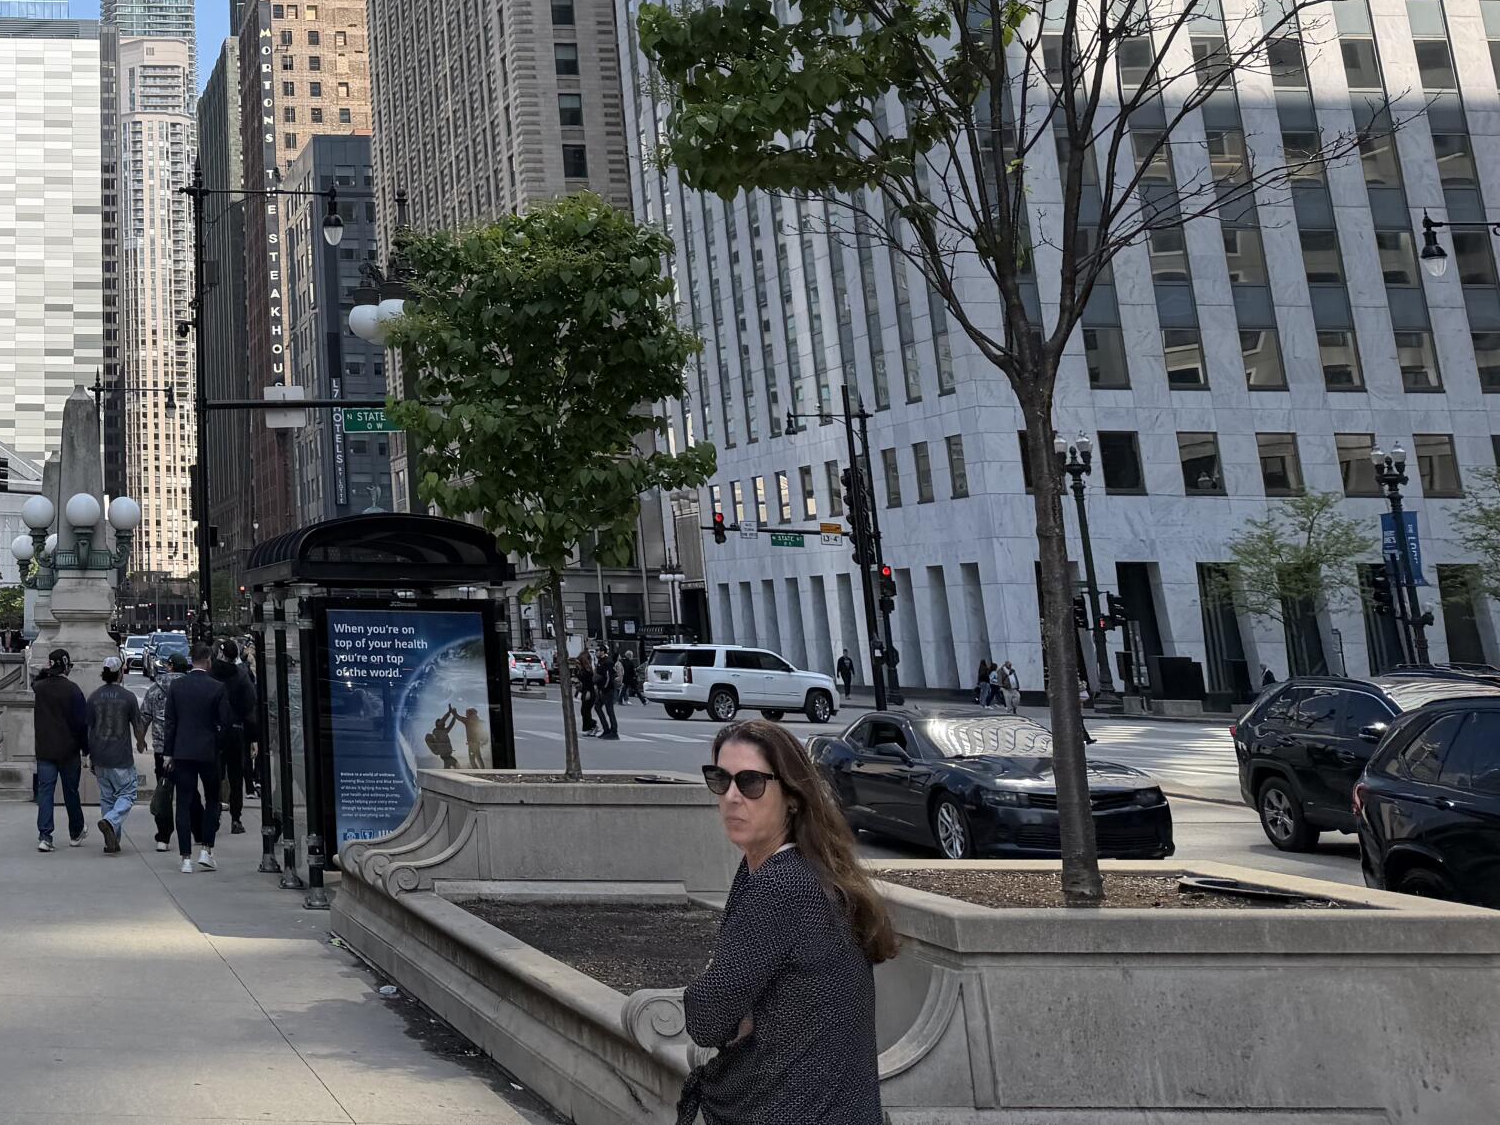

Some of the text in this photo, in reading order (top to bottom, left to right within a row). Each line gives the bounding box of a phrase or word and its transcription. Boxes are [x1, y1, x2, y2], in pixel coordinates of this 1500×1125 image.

[260, 28, 274, 143] MORTONS
[266, 169, 284, 387] THE STEAKHOU
[332, 379, 339, 398] L7
[357, 411, 387, 422] STATE
[376, 422, 383, 430] W
[334, 623, 415, 636] When you're on
[334, 638, 428, 651] top of your health
[335, 653, 404, 666] you're on top
[336, 667, 403, 678] of the world.
